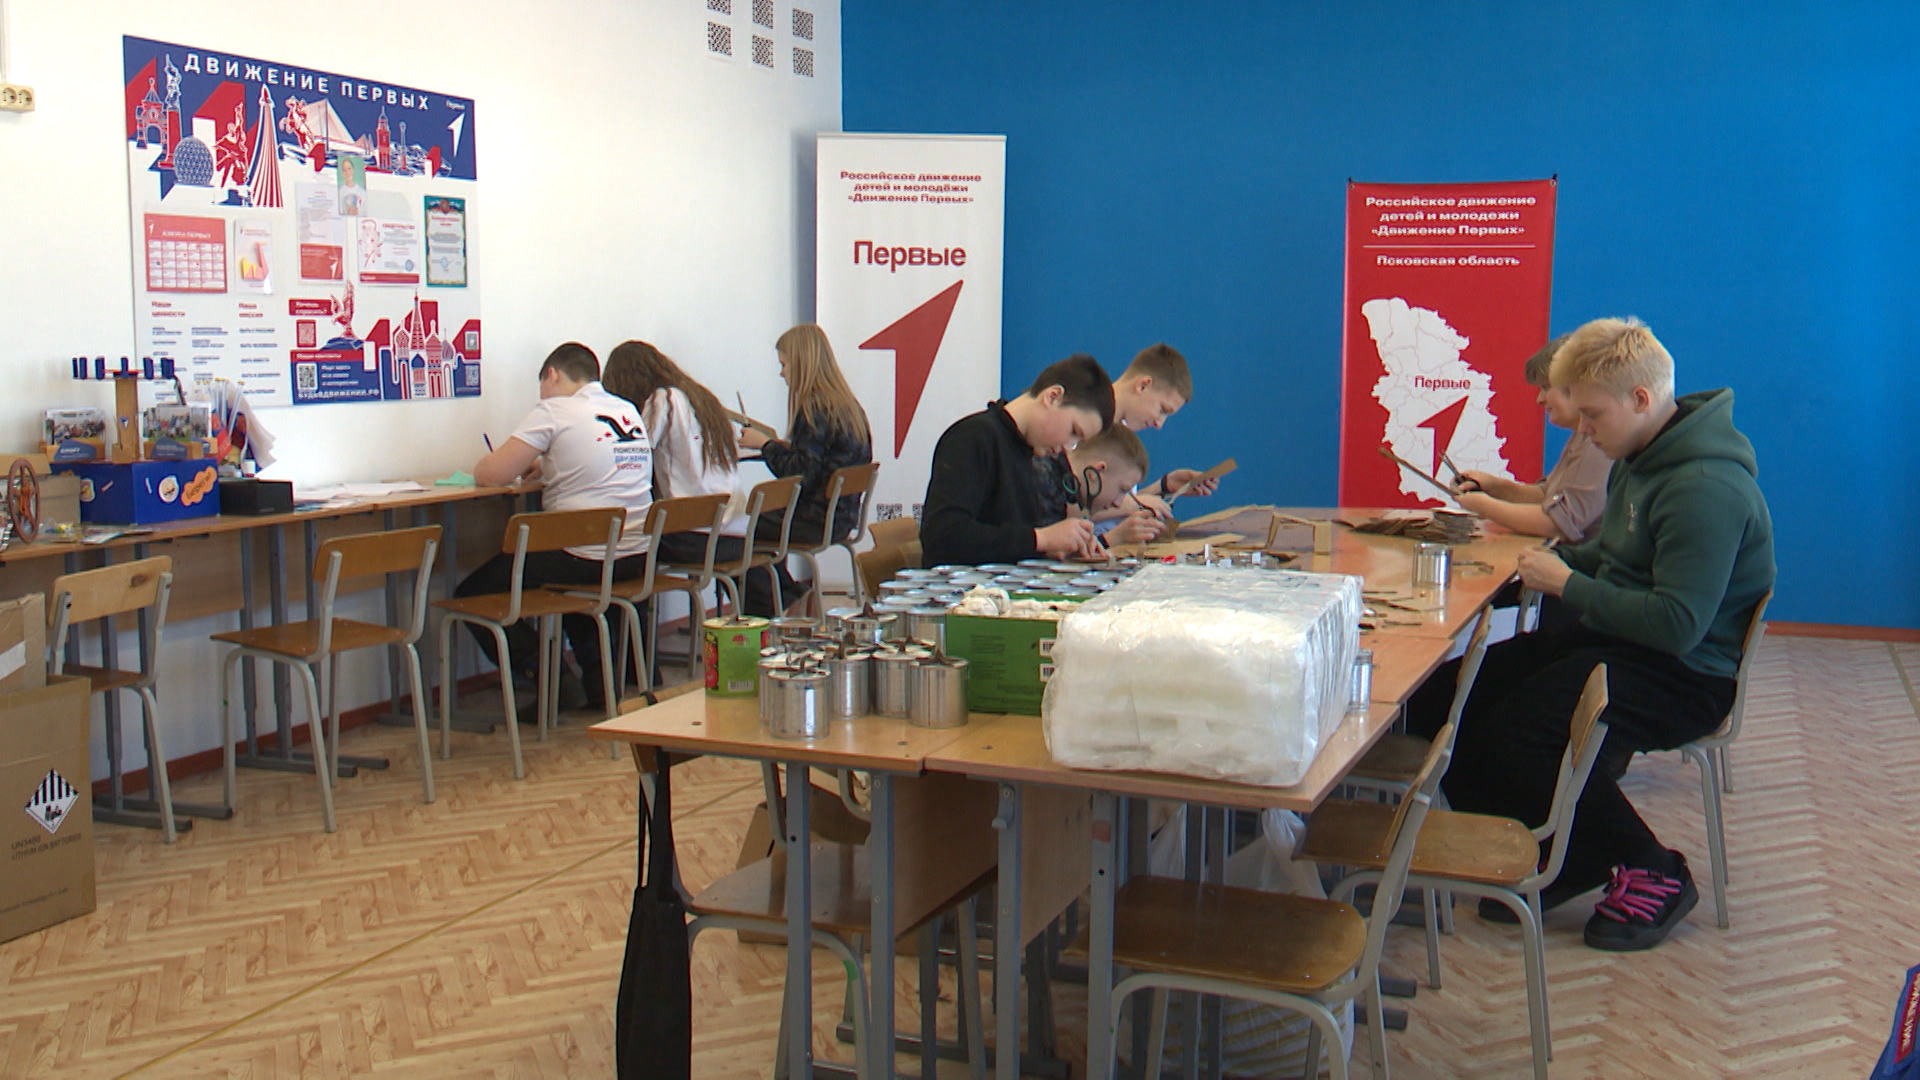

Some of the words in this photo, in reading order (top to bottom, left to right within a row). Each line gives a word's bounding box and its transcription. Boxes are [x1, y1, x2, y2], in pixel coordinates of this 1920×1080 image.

[184, 53, 330, 94] ДВИЖЕНИЕ
[340, 81, 429, 110] ПЕРВЫХ
[840, 171, 916, 181] Российское
[917, 173, 982, 182] движение
[853, 183, 891, 192] детей
[847, 193, 918, 203] «Движение
[920, 193, 974, 204] Первых»
[1365, 196, 1455, 207] Российское
[1457, 196, 1537, 208] движение
[1379, 210, 1425, 222] детей
[1427, 212, 1437, 220] и
[1439, 211, 1520, 222] молодежи
[1371, 225, 1456, 236] «Движение
[1458, 225, 1525, 236] Первых»
[854, 240, 967, 273] Первые
[1377, 255, 1456, 266] Псковская
[1458, 255, 1520, 266] область
[1414, 375, 1471, 391] Первые
